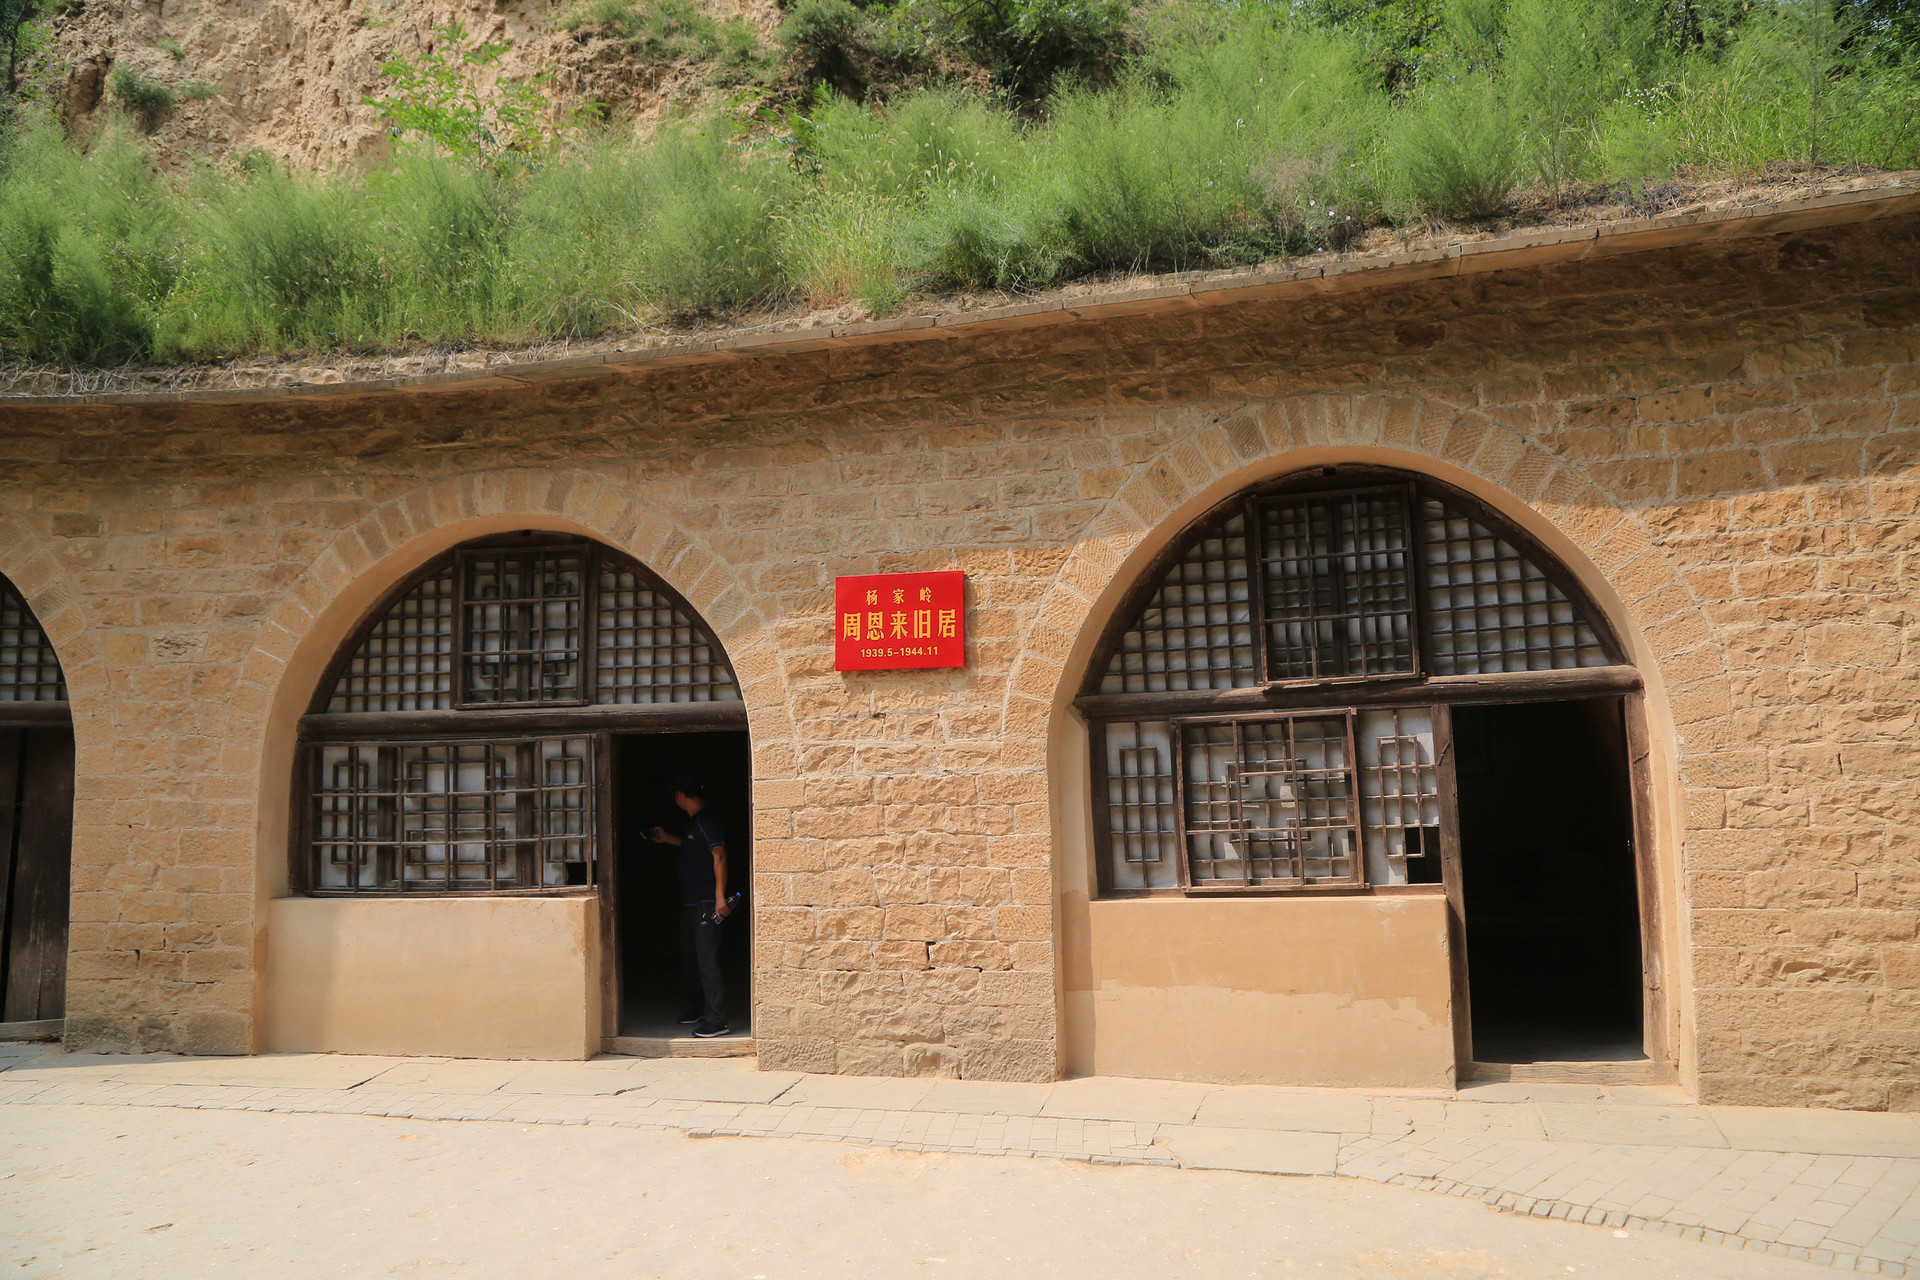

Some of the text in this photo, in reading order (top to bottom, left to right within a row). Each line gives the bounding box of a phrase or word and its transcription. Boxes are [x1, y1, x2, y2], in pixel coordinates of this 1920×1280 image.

[866, 587, 932, 606] 杨家岭
[843, 609, 956, 641] 周恩来旧居
[861, 646, 939, 658] 1939.5-1944.11
